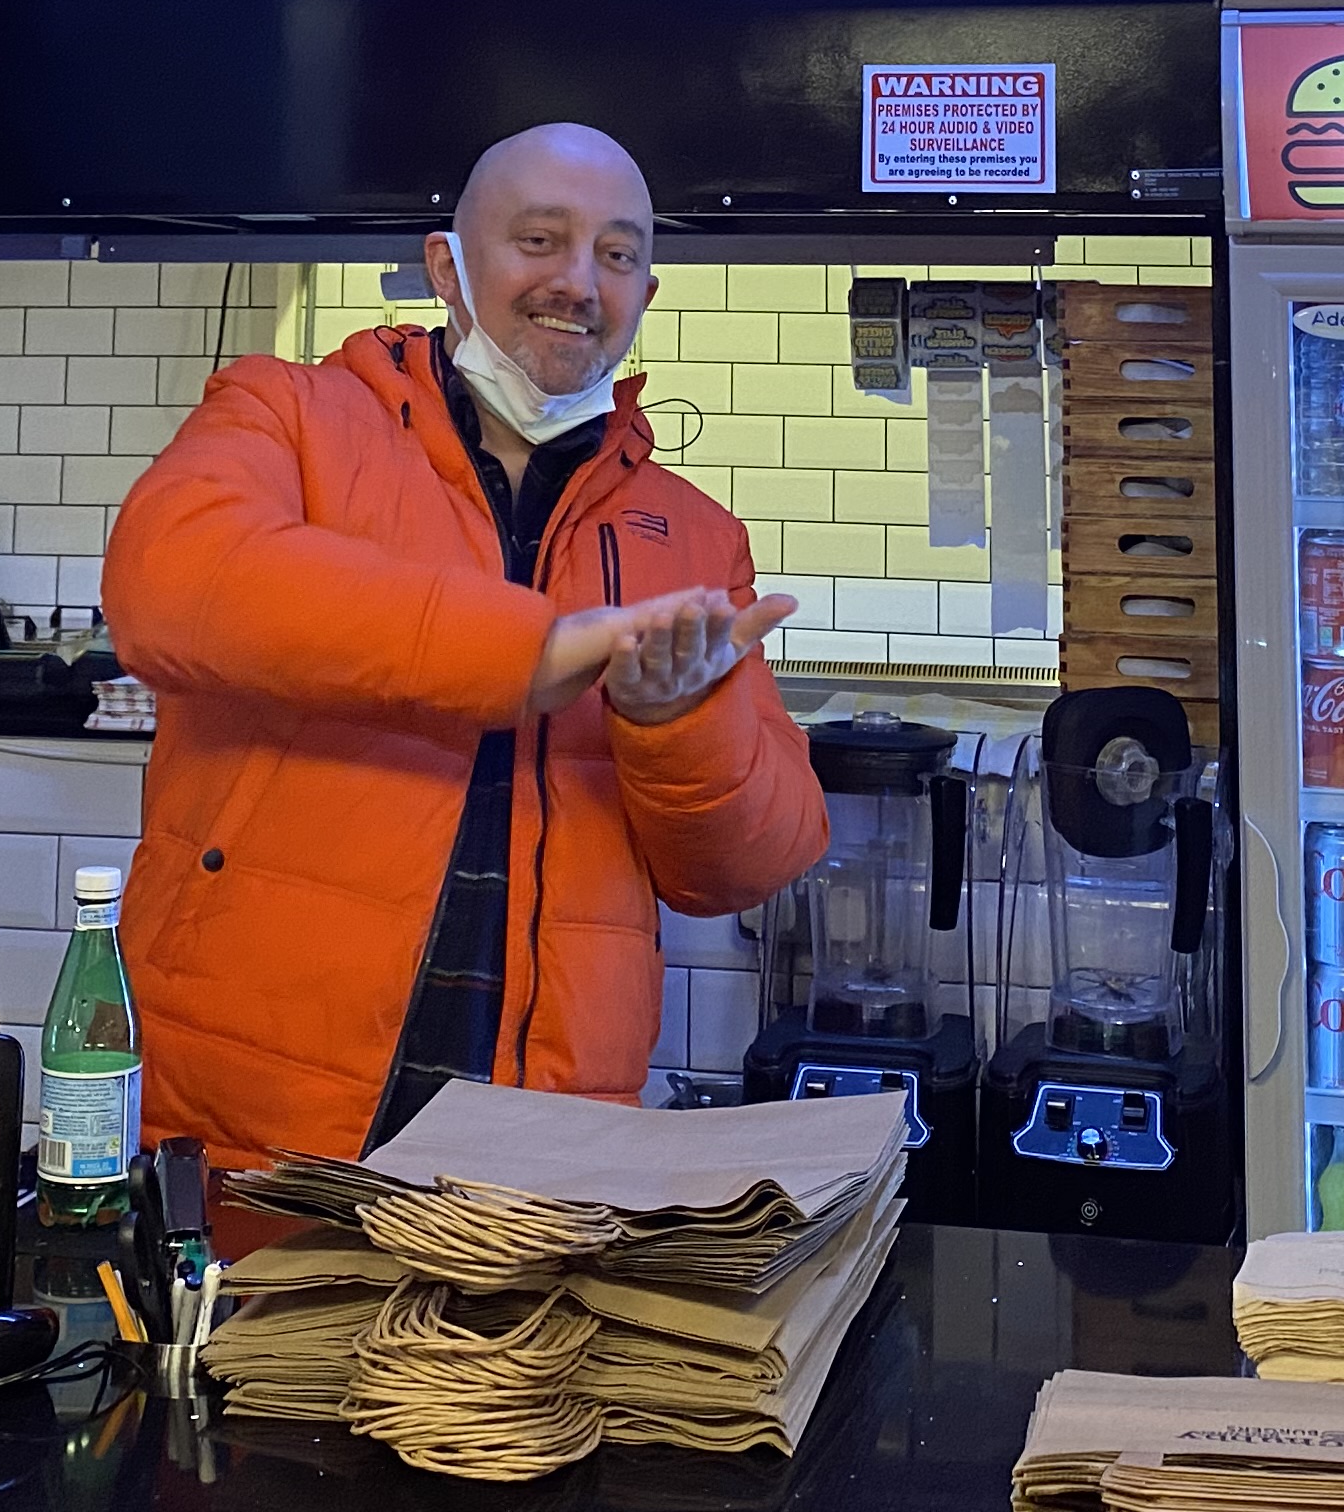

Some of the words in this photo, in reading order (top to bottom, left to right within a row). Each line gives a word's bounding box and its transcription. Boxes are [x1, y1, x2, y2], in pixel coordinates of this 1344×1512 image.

[877, 76, 1040, 96] WARNING
[877, 103, 940, 118] PREMISES
[943, 103, 1018, 118] PROTECTED
[1021, 103, 1040, 118] BY
[880, 120, 896, 135] 24
[899, 120, 935, 135] HOUR
[938, 120, 979, 135] AUDIO
[982, 120, 992, 135] &
[995, 120, 1035, 135] VIDEO
[909, 137, 1006, 152] SURVEILLANCE
[878, 153, 891, 166] By
[893, 153, 936, 166] entering
[938, 153, 967, 164] these
[969, 154, 1017, 166] premises
[1019, 156, 1038, 166] you
[888, 168, 905, 177] are
[907, 167, 953, 180] agreeing
[955, 167, 966, 177] to
[968, 167, 981, 177] be
[983, 167, 1030, 177] recorded
